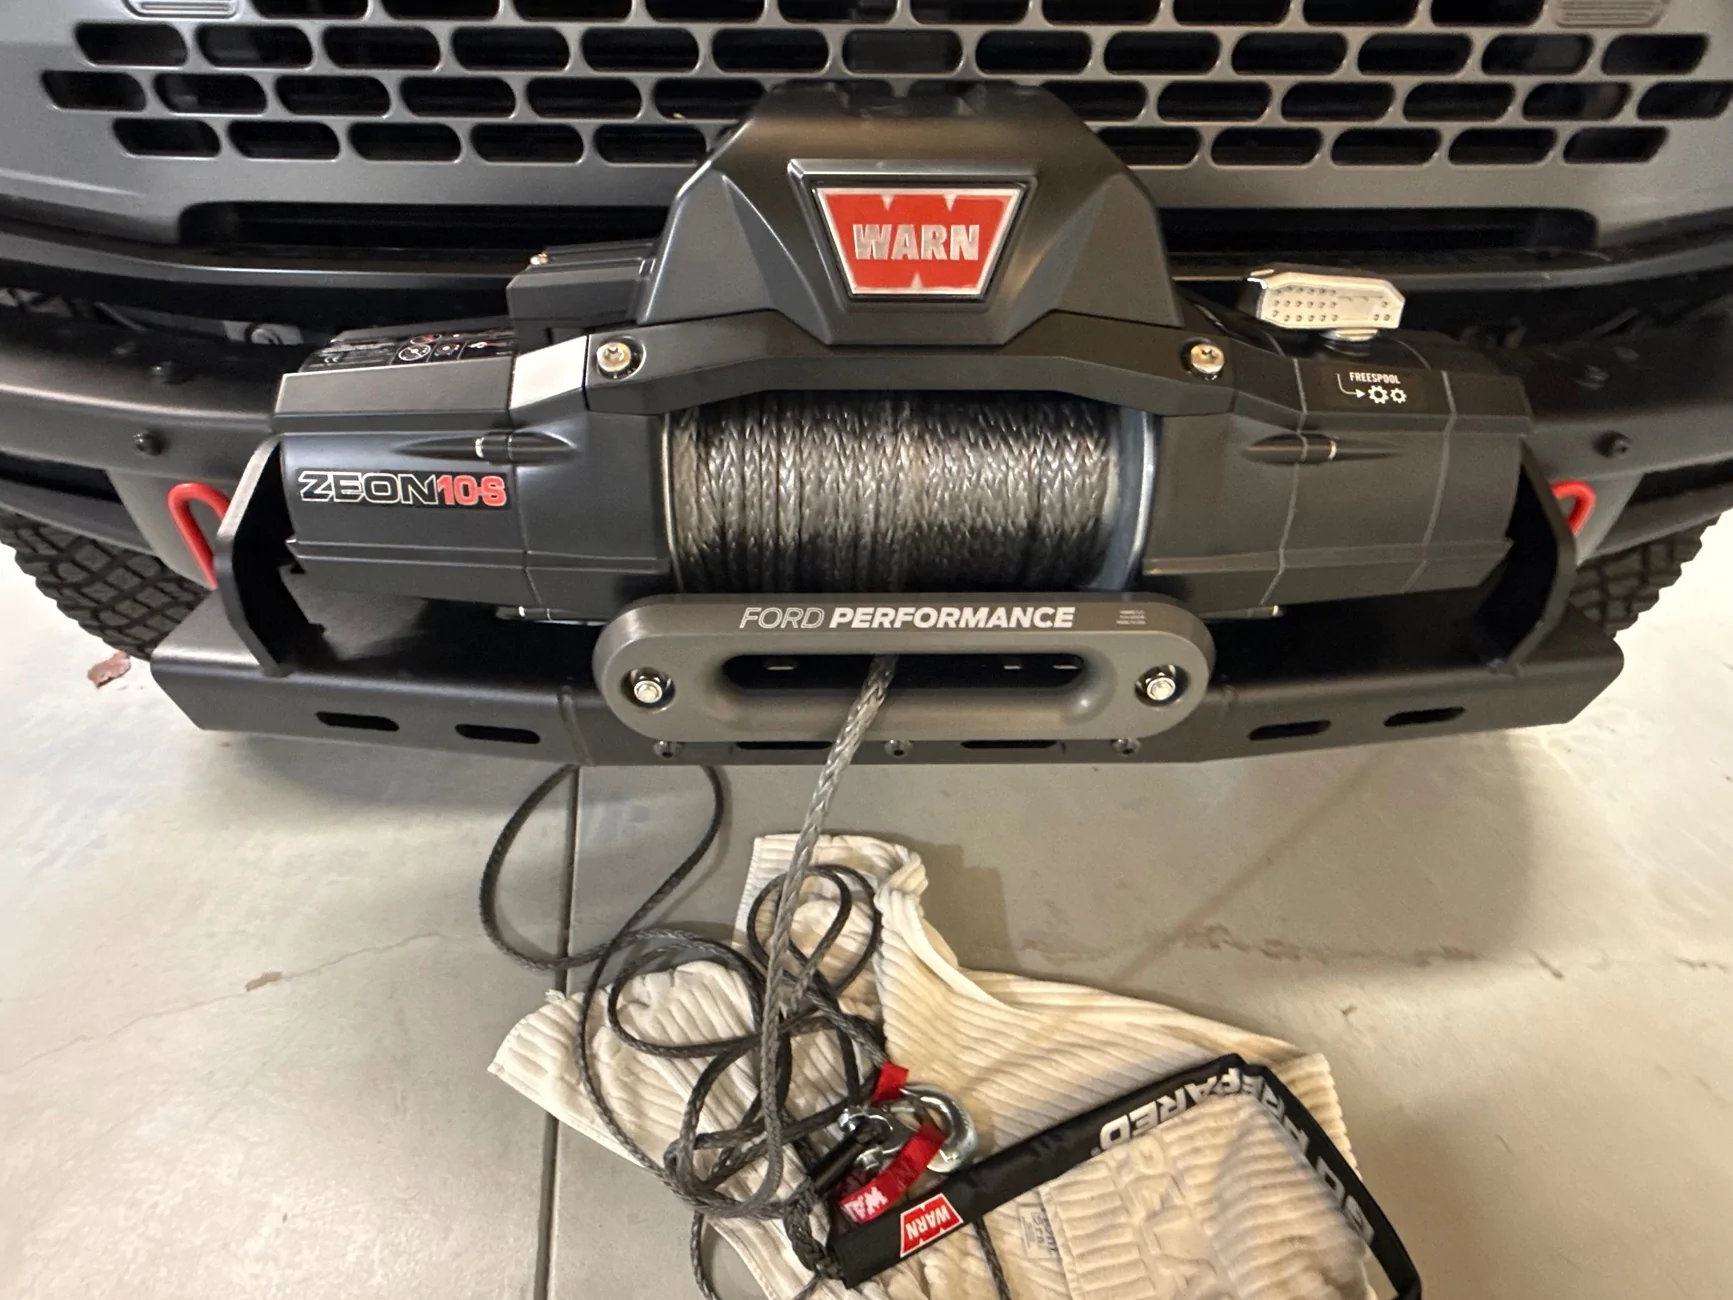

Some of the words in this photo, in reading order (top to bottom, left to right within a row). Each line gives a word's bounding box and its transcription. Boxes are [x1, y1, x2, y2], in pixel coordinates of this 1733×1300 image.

[853, 224, 980, 260] WARN
[1349, 372, 1401, 385] FREESPOOL
[298, 471, 438, 504] ZEON
[739, 607, 825, 629] FORD
[829, 607, 1075, 629] PERFORMANCE
[905, 1205, 951, 1240] WARN
